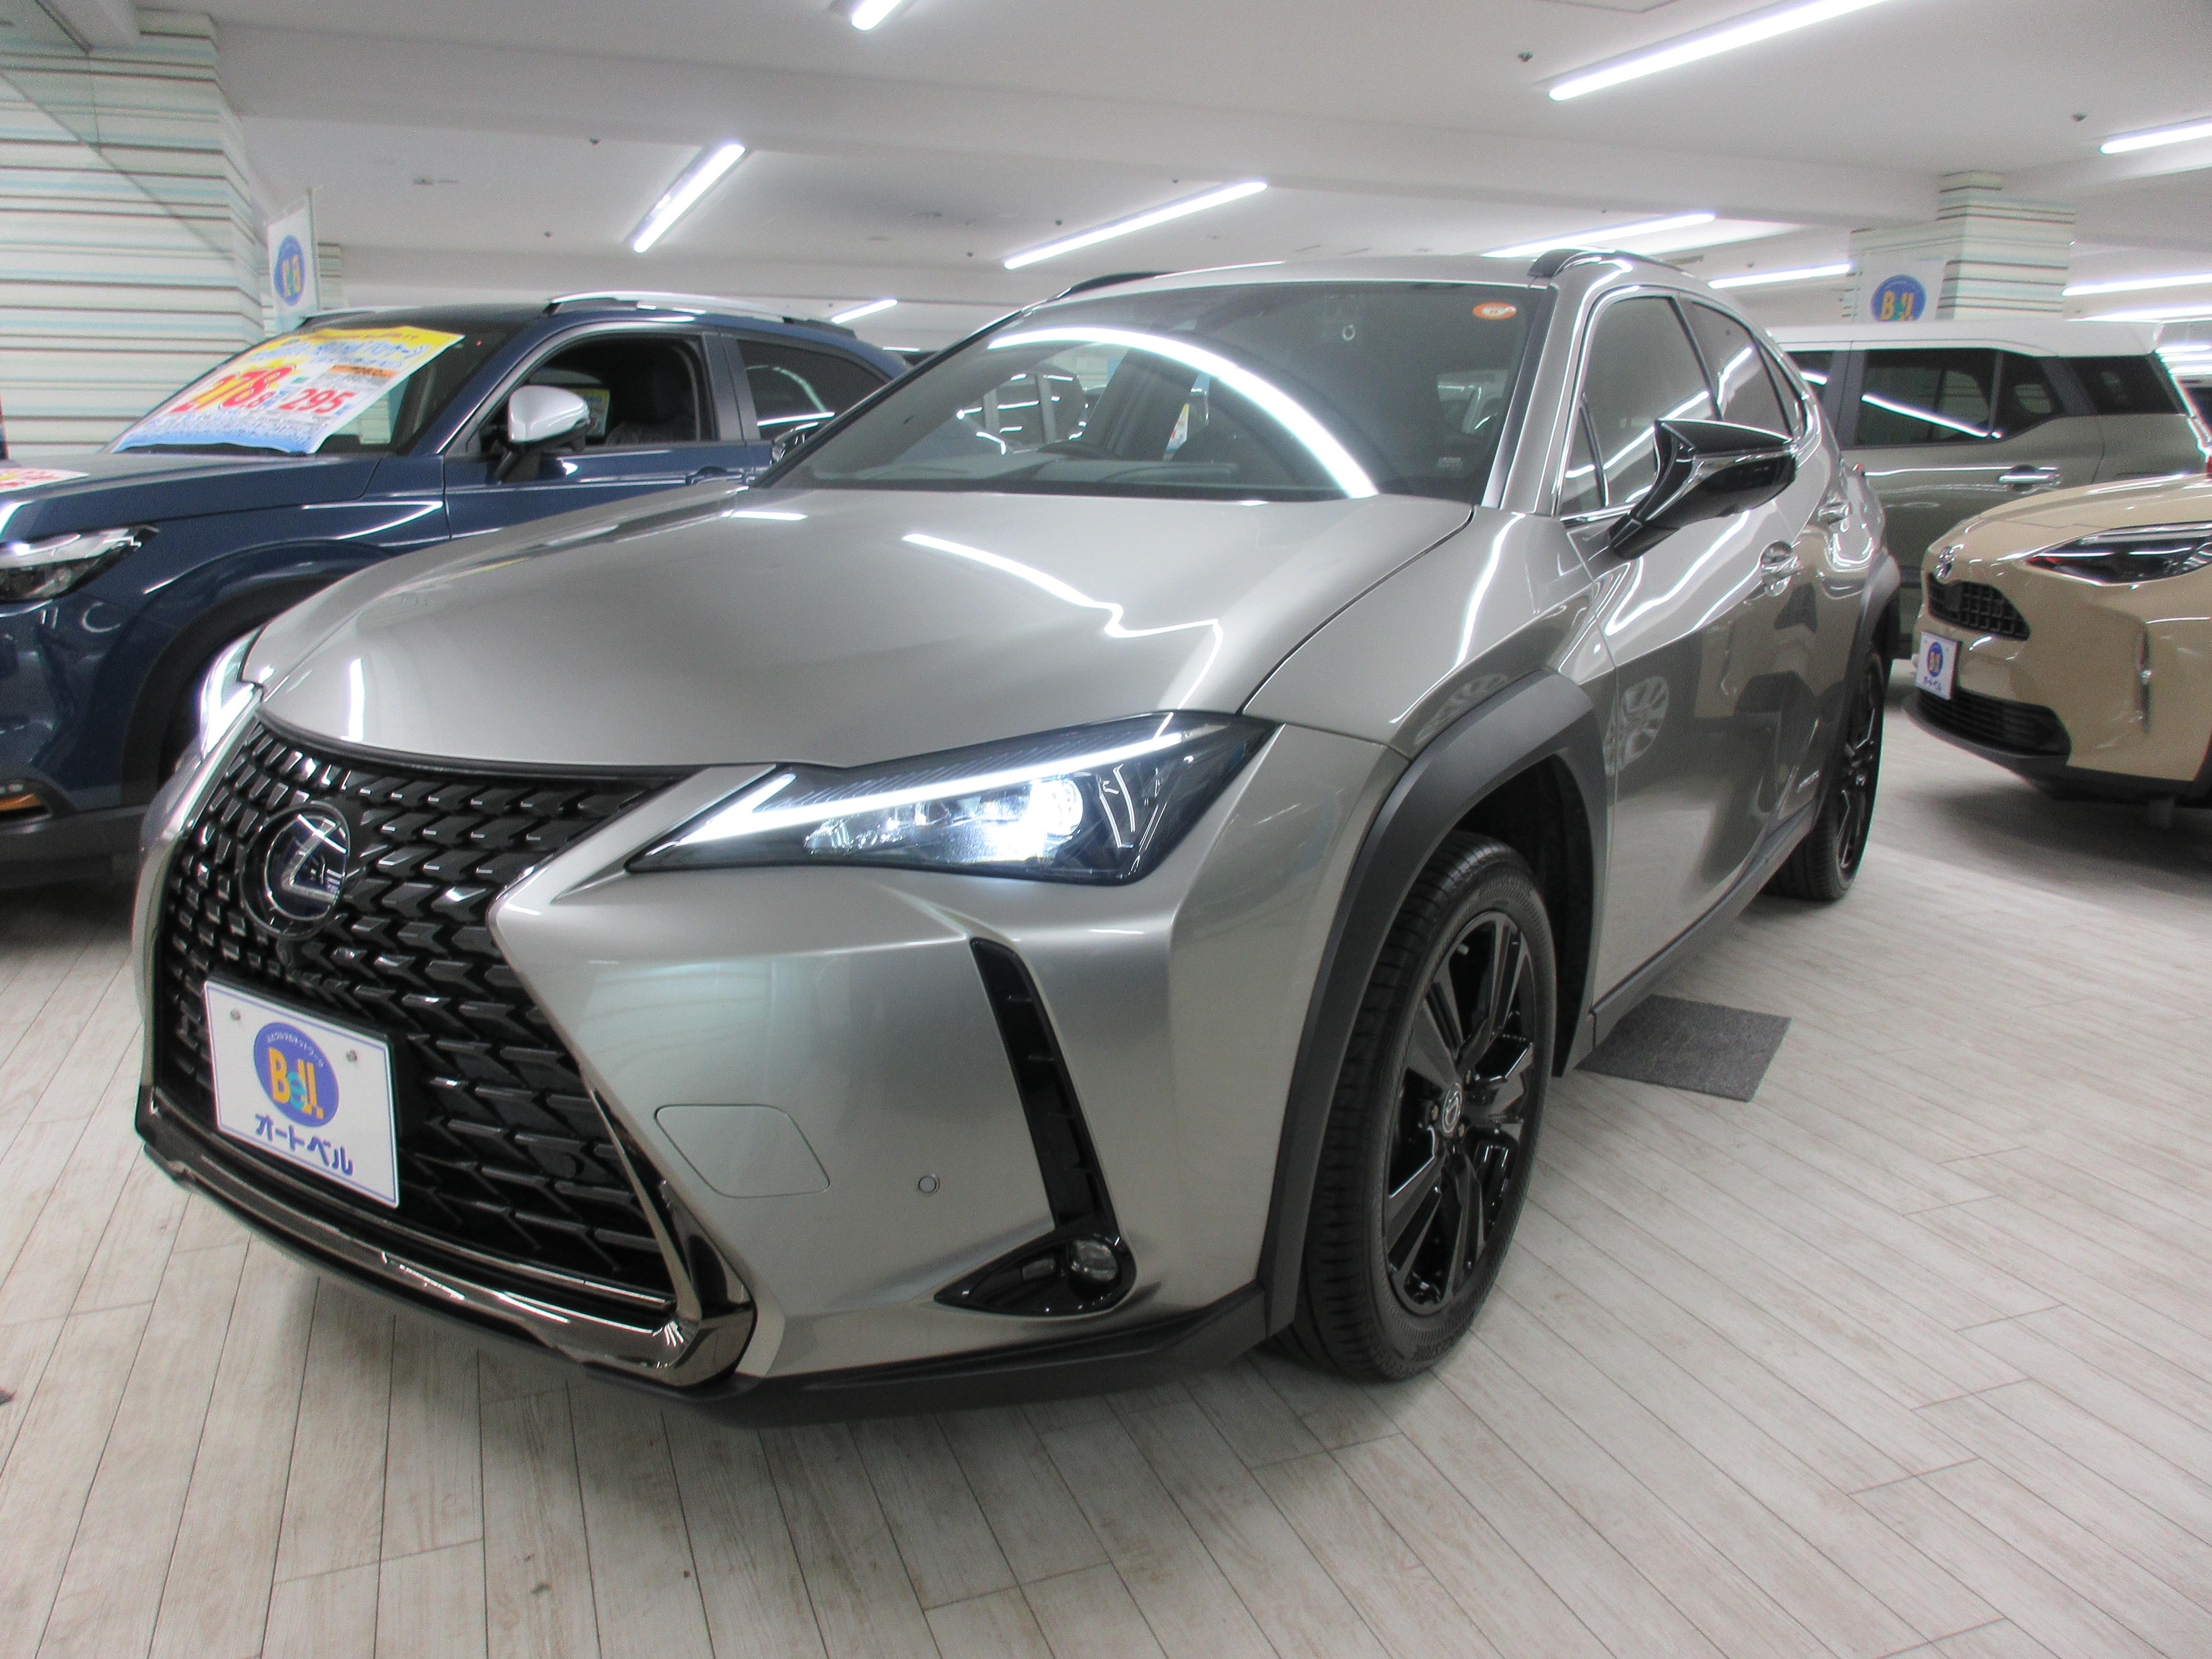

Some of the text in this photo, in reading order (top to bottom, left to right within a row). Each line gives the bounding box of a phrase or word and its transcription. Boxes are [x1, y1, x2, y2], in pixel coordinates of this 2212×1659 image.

[278, 387, 357, 414] 295
[255, 1113, 354, 1176] オートベル
